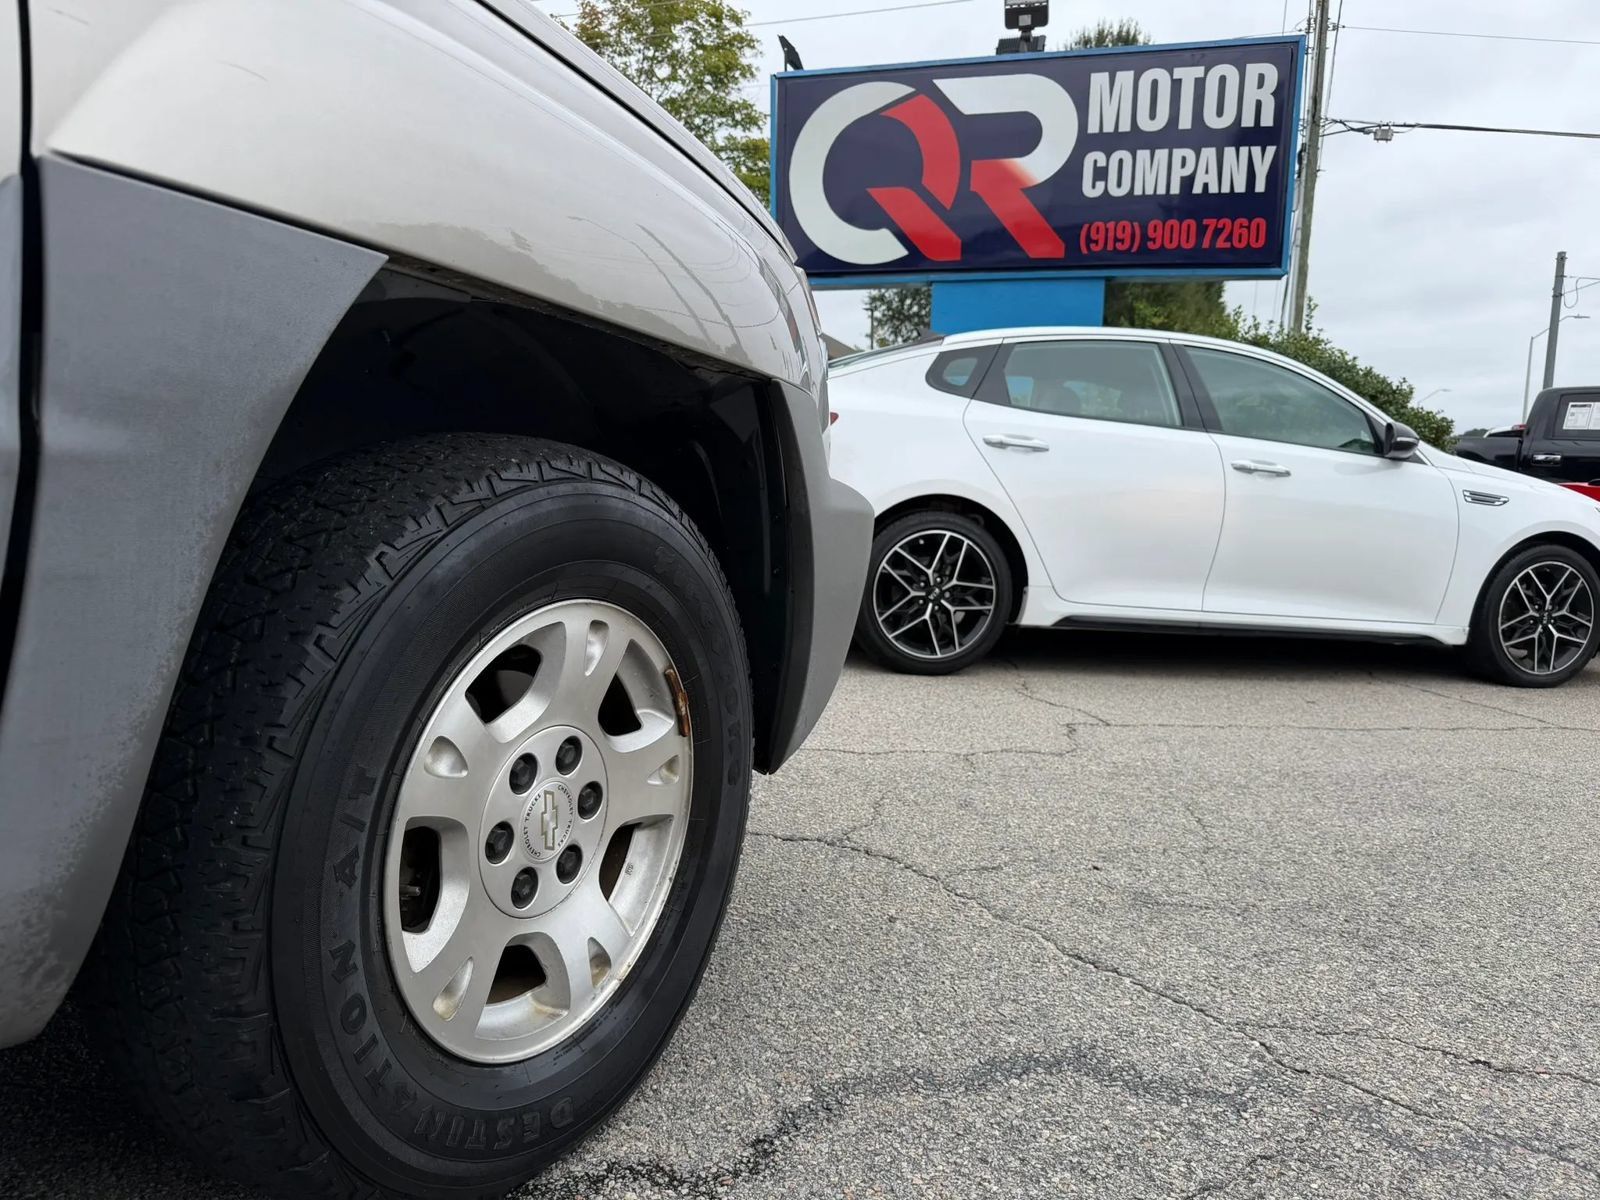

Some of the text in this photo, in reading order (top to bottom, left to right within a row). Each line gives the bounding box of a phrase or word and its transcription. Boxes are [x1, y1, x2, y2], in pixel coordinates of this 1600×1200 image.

[1087, 62, 1280, 135] MOTOR
[1081, 145, 1277, 198] COMPANY
[1079, 217, 1266, 255] (919) 900 7260
[524, 793, 541, 823] TRUCKS
